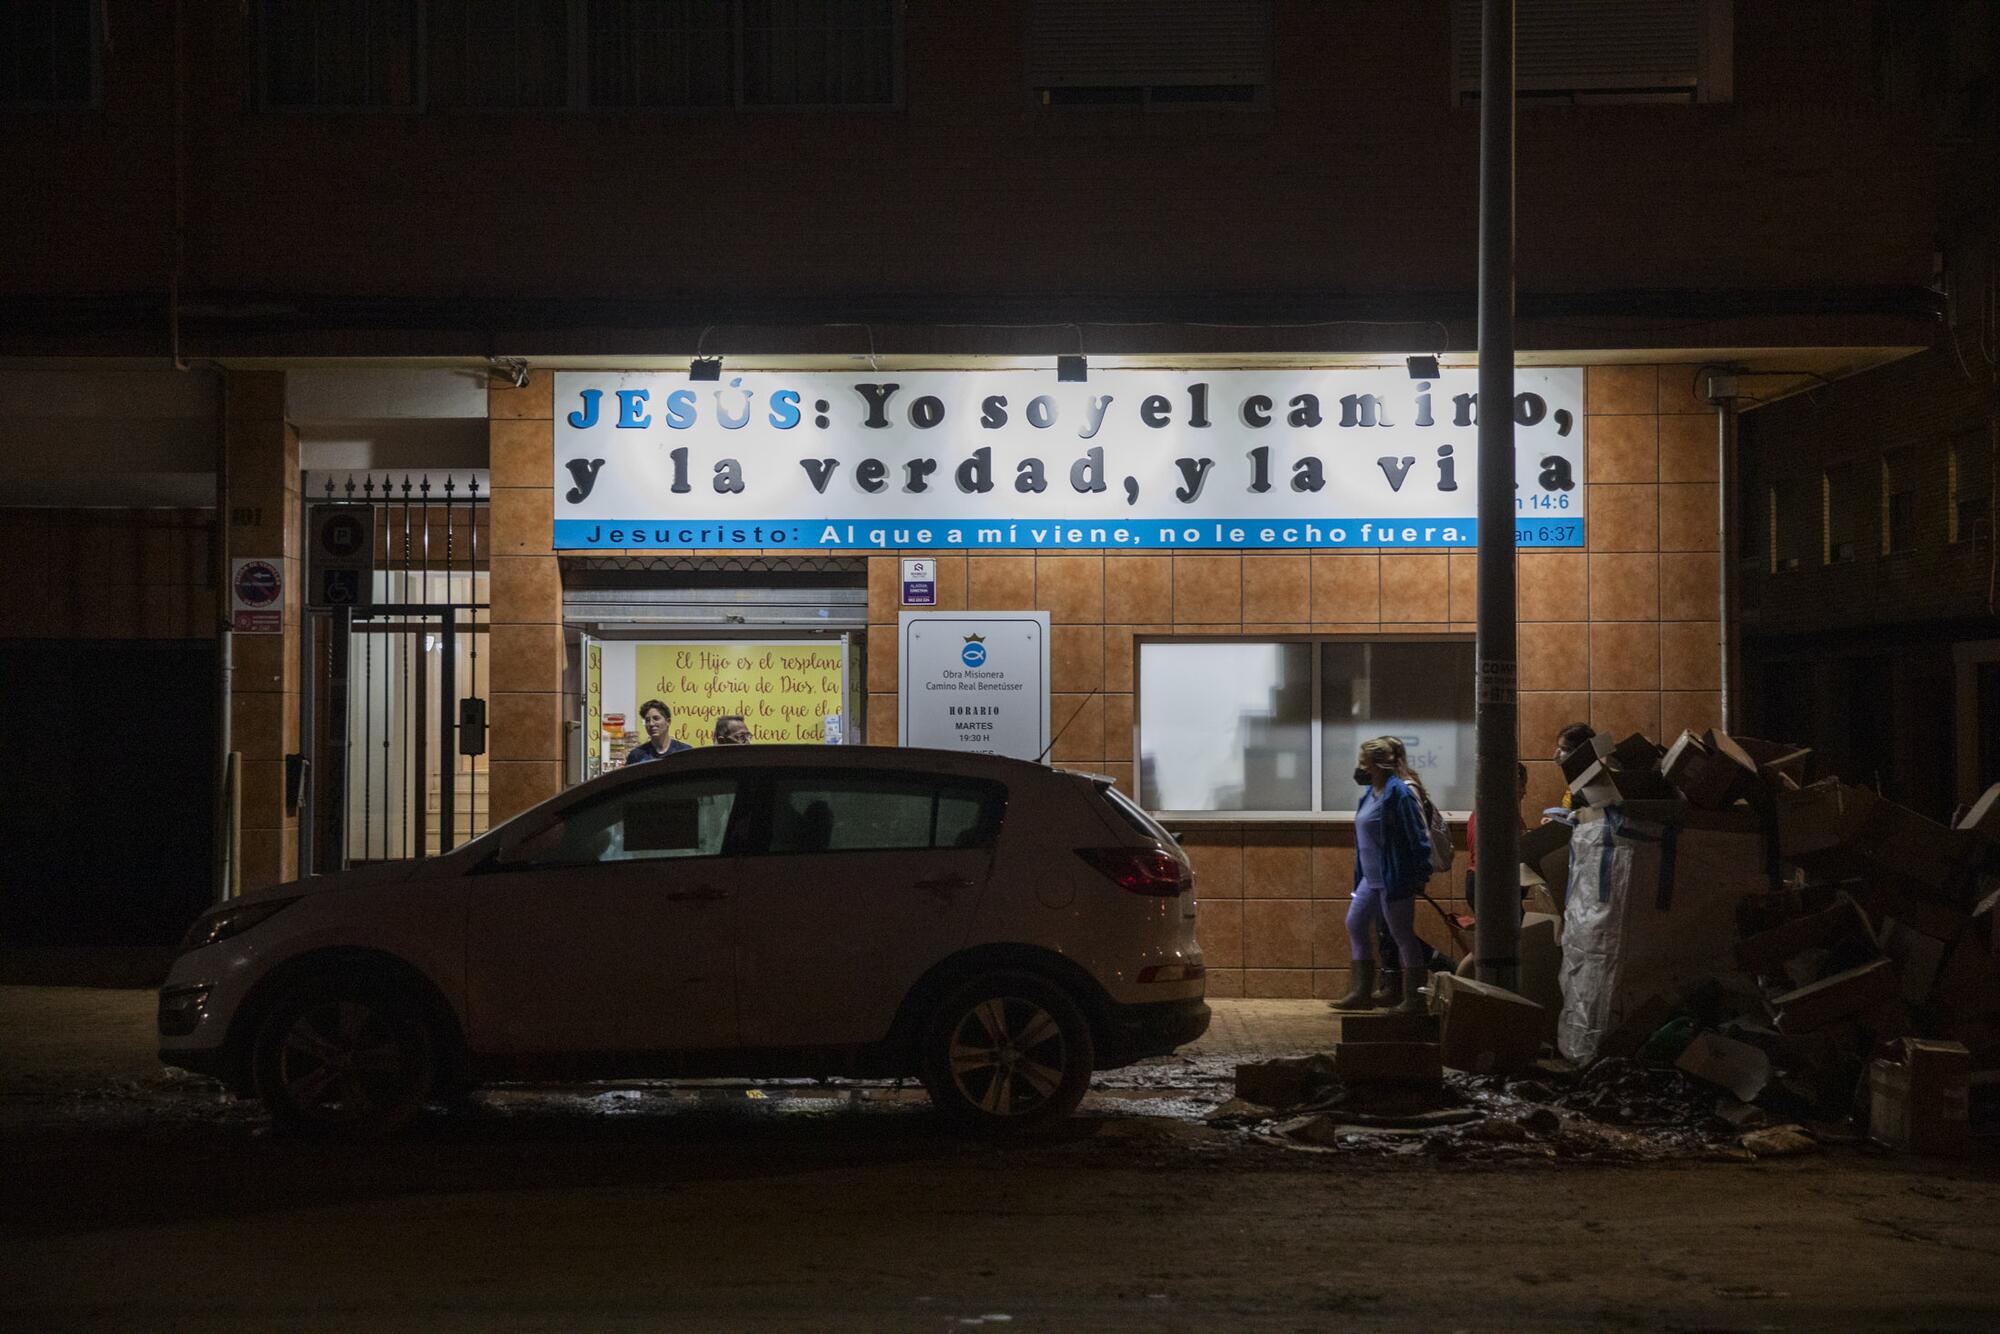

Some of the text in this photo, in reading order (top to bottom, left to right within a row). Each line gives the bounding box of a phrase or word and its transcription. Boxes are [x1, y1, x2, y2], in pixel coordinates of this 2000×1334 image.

[854, 383, 946, 430] Yo
[980, 394, 1113, 439] soy
[1140, 383, 1212, 428] el
[565, 444, 1576, 505] y la verdad, y la via
[1530, 494, 1569, 509] 14:6
[586, 525, 799, 543] Jesucristo:
[819, 525, 854, 543] Al
[869, 527, 933, 547] que
[947, 528, 962, 543] a
[978, 525, 1017, 543] mí
[1031, 526, 1140, 545] viene,
[1159, 528, 1201, 542] no
[1215, 524, 1245, 542] le
[1260, 524, 1347, 542] echo
[1360, 524, 1466, 542] fuera.
[1539, 526, 1575, 541] 6:37
[675, 651, 693, 669] El
[699, 651, 731, 674] Hijo
[737, 657, 753, 670] es
[759, 652, 775, 669] el
[942, 670, 1004, 679] Obra Misionera
[657, 676, 675, 693] de
[681, 676, 698, 693] la
[704, 676, 751, 698] gloria
[755, 676, 774, 694] de
[822, 676, 839, 694] la
[926, 681, 1023, 691] Camino Real Benetússer
[672, 701, 730, 722] imagen
[735, 700, 754, 717] de
[759, 699, 776, 717] lo
[781, 704, 810, 722] que
[949, 706, 1000, 716] HORARIO
[674, 723, 690, 741] el
[695, 728, 714, 745] qu
[955, 722, 993, 730] MARTES
[959, 734, 990, 742] 19:30 H
